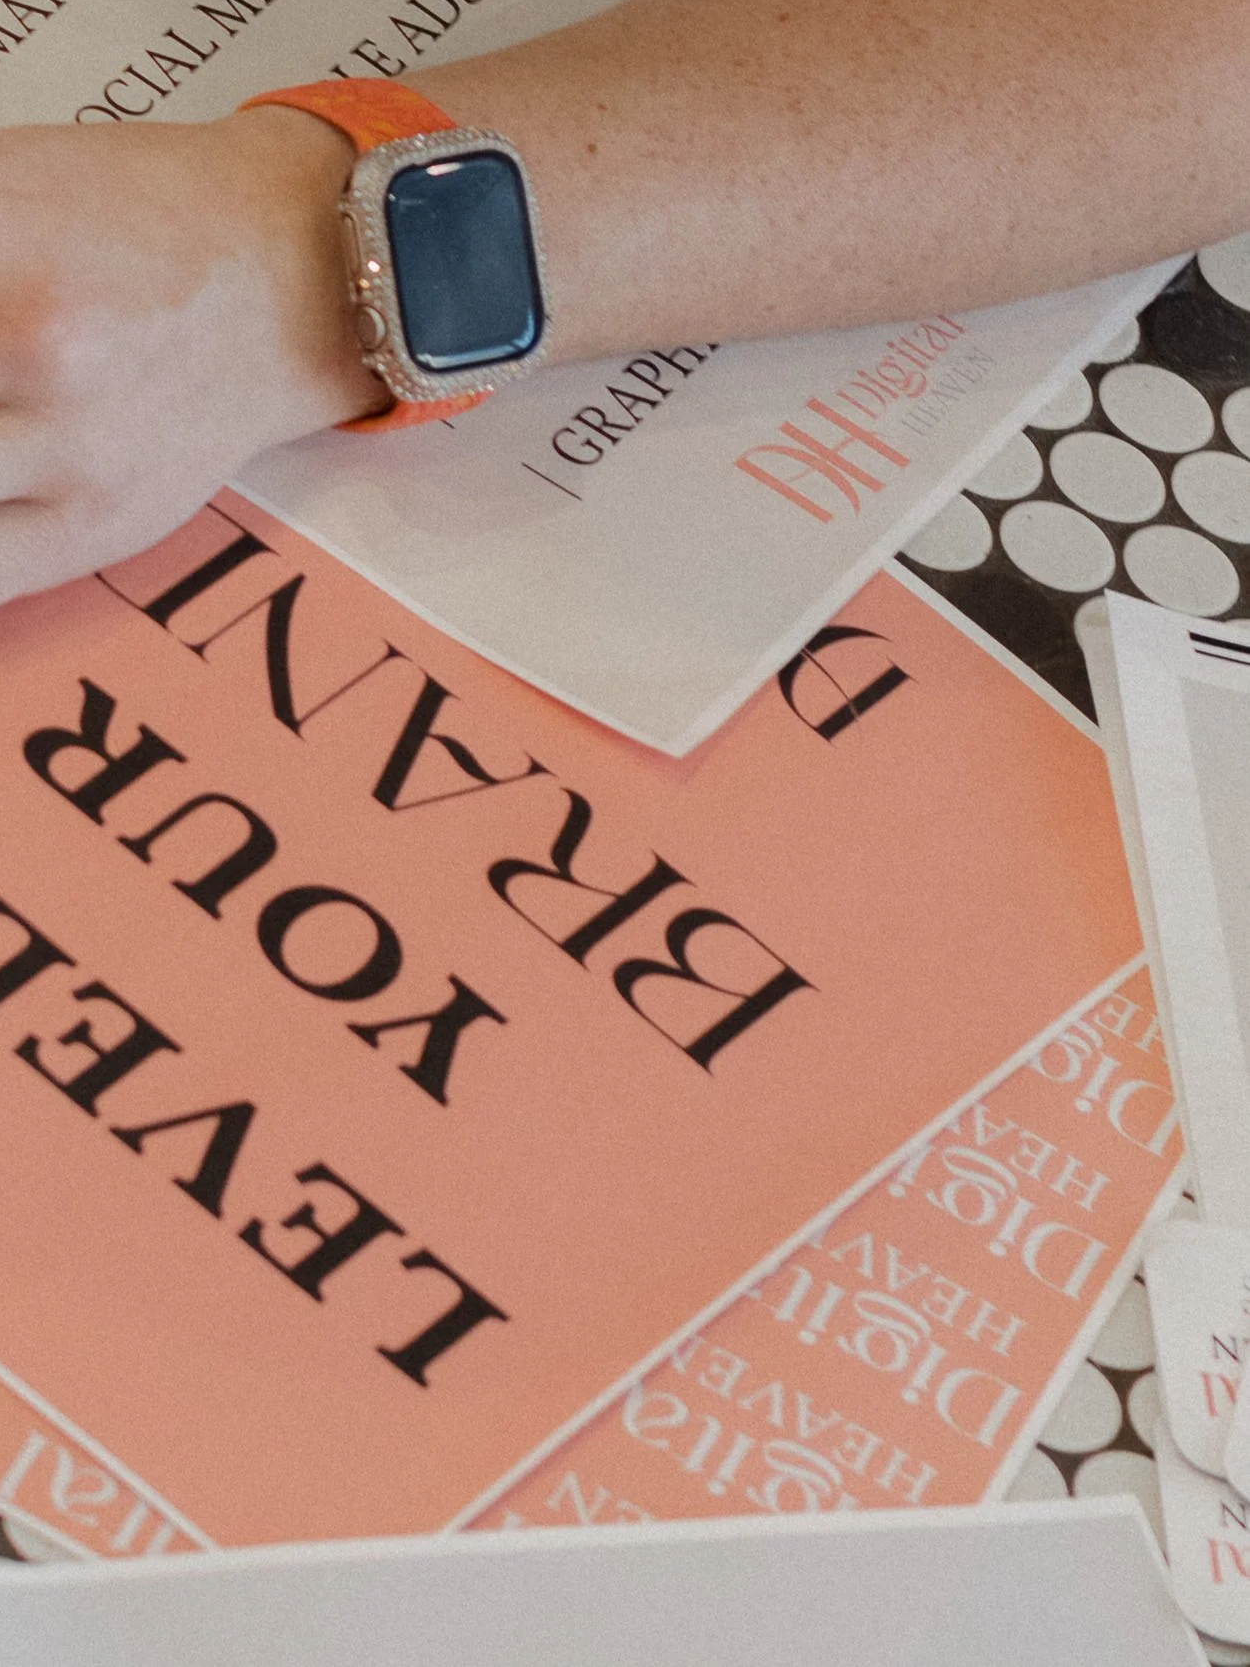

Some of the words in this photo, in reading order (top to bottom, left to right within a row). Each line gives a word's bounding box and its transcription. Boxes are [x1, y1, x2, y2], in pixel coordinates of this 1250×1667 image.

[75, 2, 221, 125] OCIAL
[552, 341, 720, 466] GRAPH
[22, 677, 508, 1108] YOUR
[887, 1138, 1113, 1302] Digi
[946, 1103, 1112, 1214] HEA
[743, 1264, 1025, 1449] Digit
[803, 1230, 1026, 1358] HEAV
